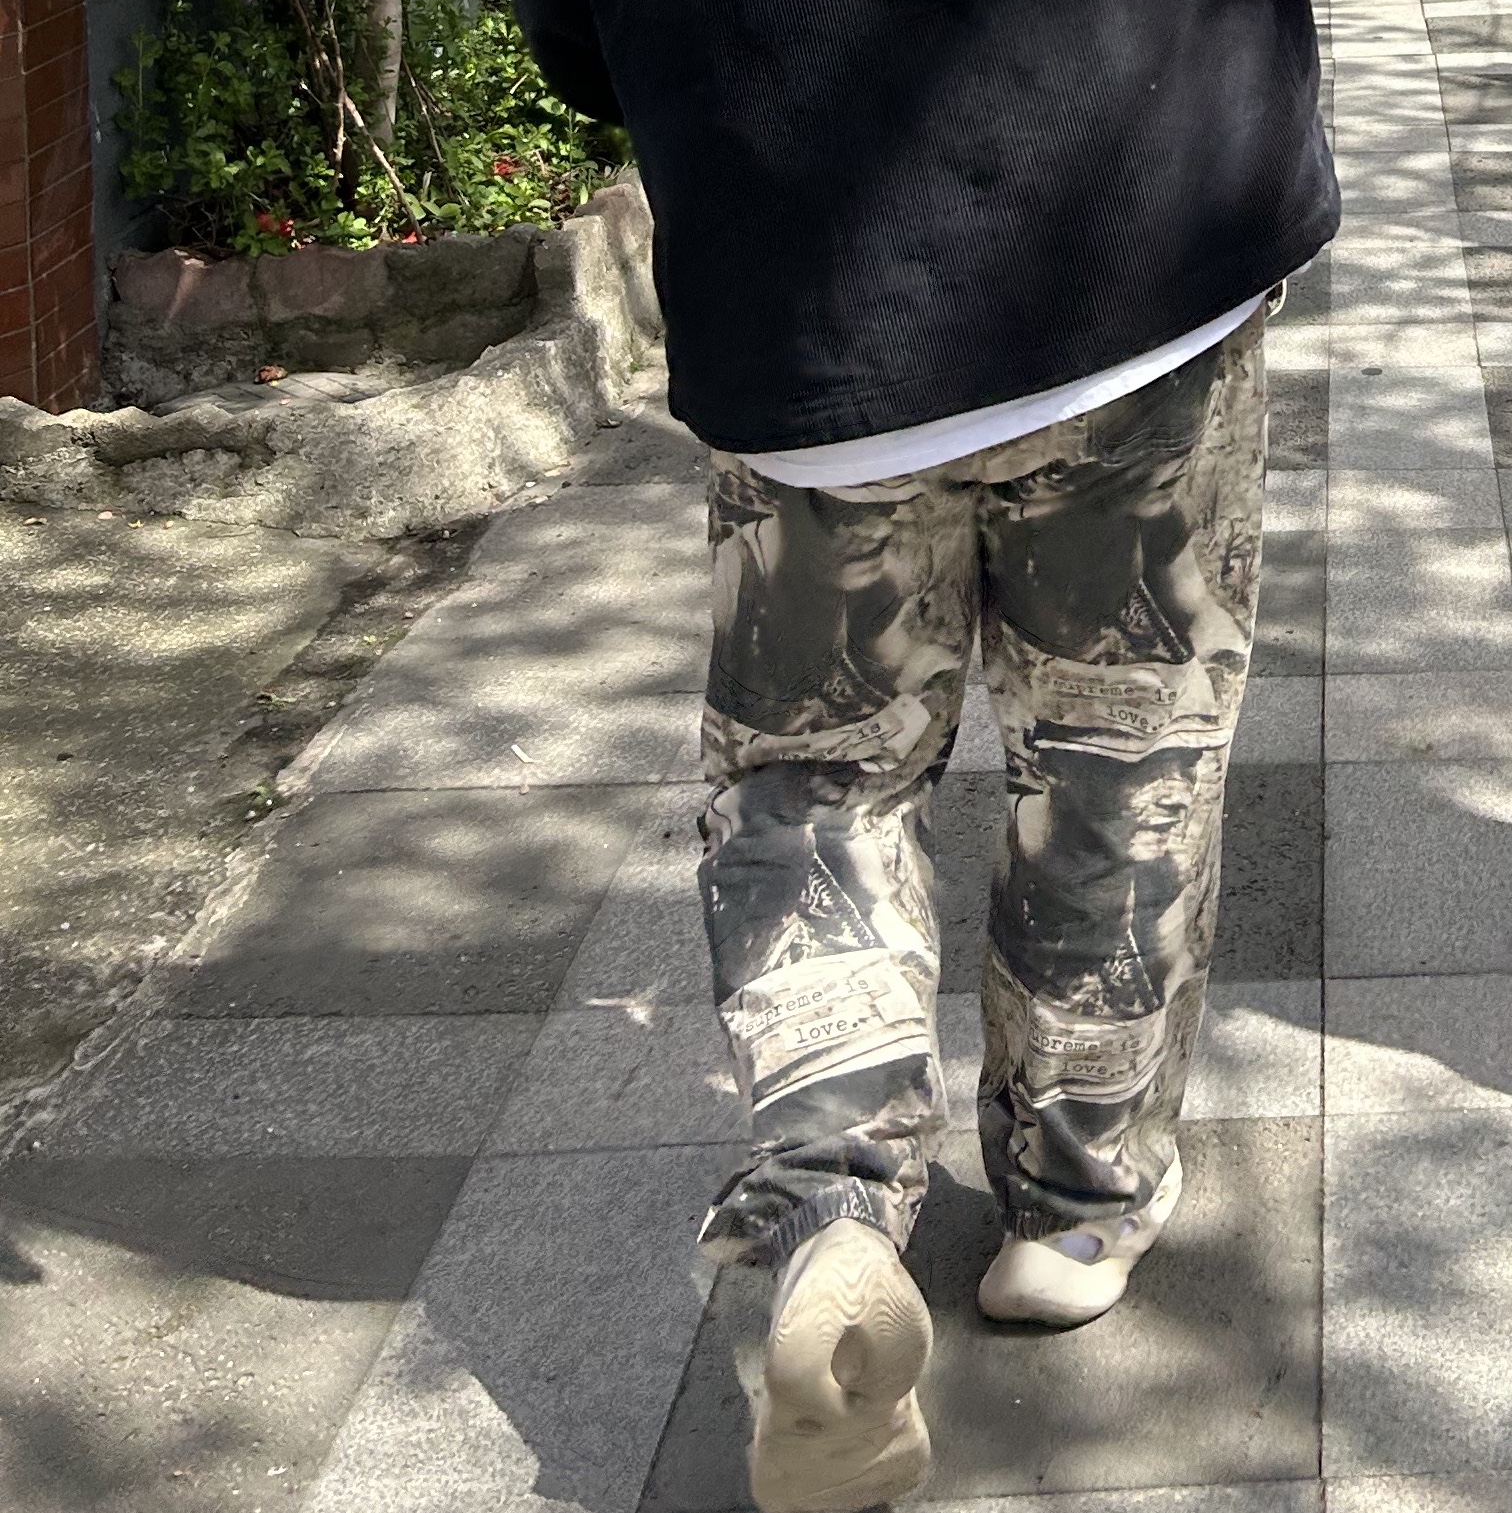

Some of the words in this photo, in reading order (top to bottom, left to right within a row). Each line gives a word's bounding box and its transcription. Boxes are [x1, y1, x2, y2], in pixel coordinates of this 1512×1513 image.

[744, 990, 824, 1033] supreme
[844, 978, 869, 994] is
[795, 1018, 859, 1044] love.
